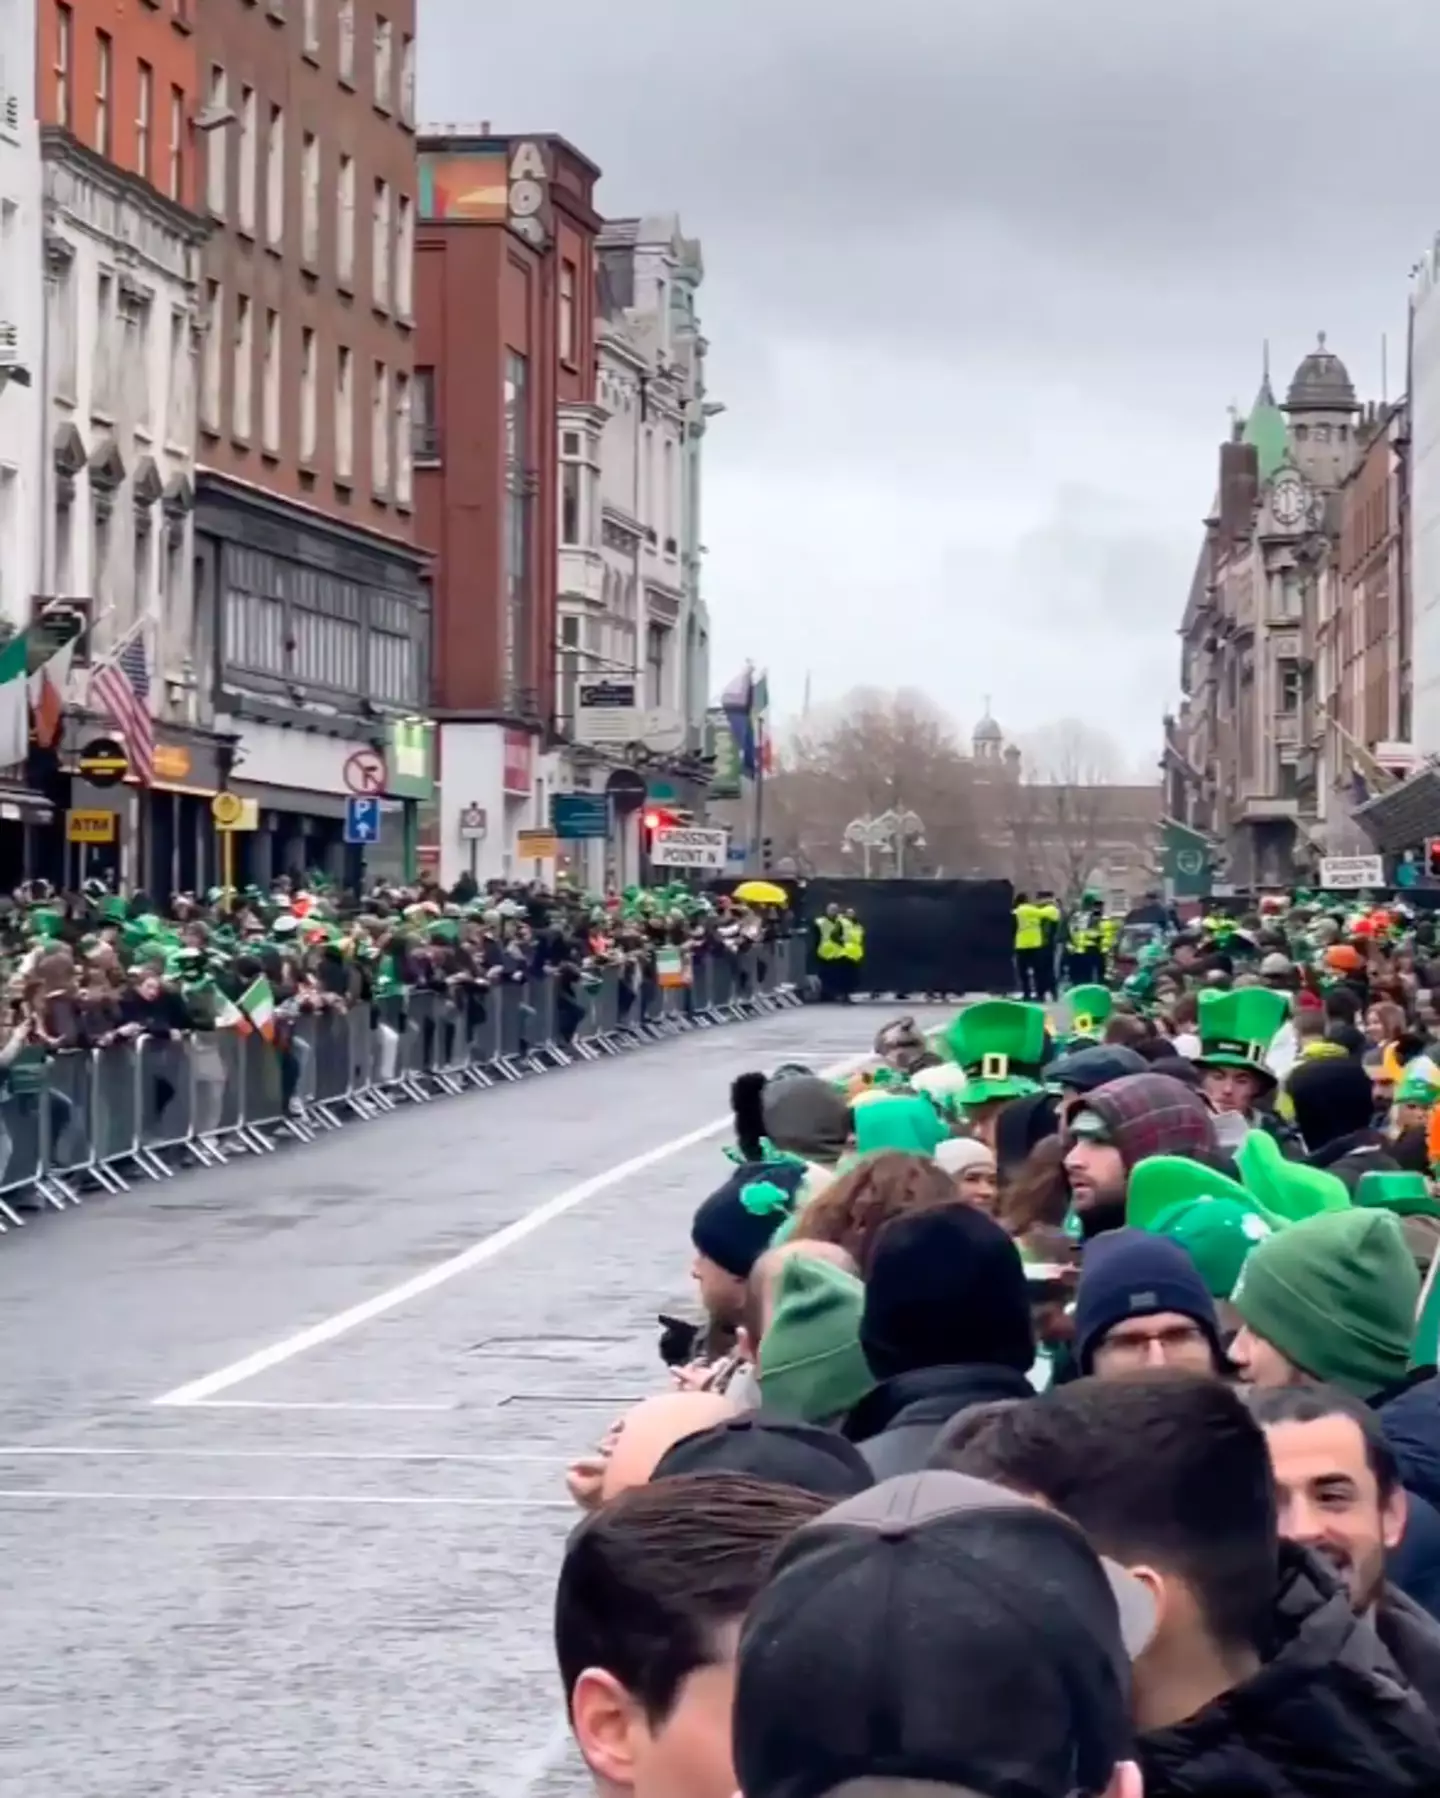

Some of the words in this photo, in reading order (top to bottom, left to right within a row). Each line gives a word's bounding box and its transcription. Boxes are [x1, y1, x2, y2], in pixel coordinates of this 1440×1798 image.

[354, 799, 370, 820] P
[72, 817, 109, 832] ATM
[659, 830, 722, 846] CROSSING
[664, 847, 703, 863] POINT
